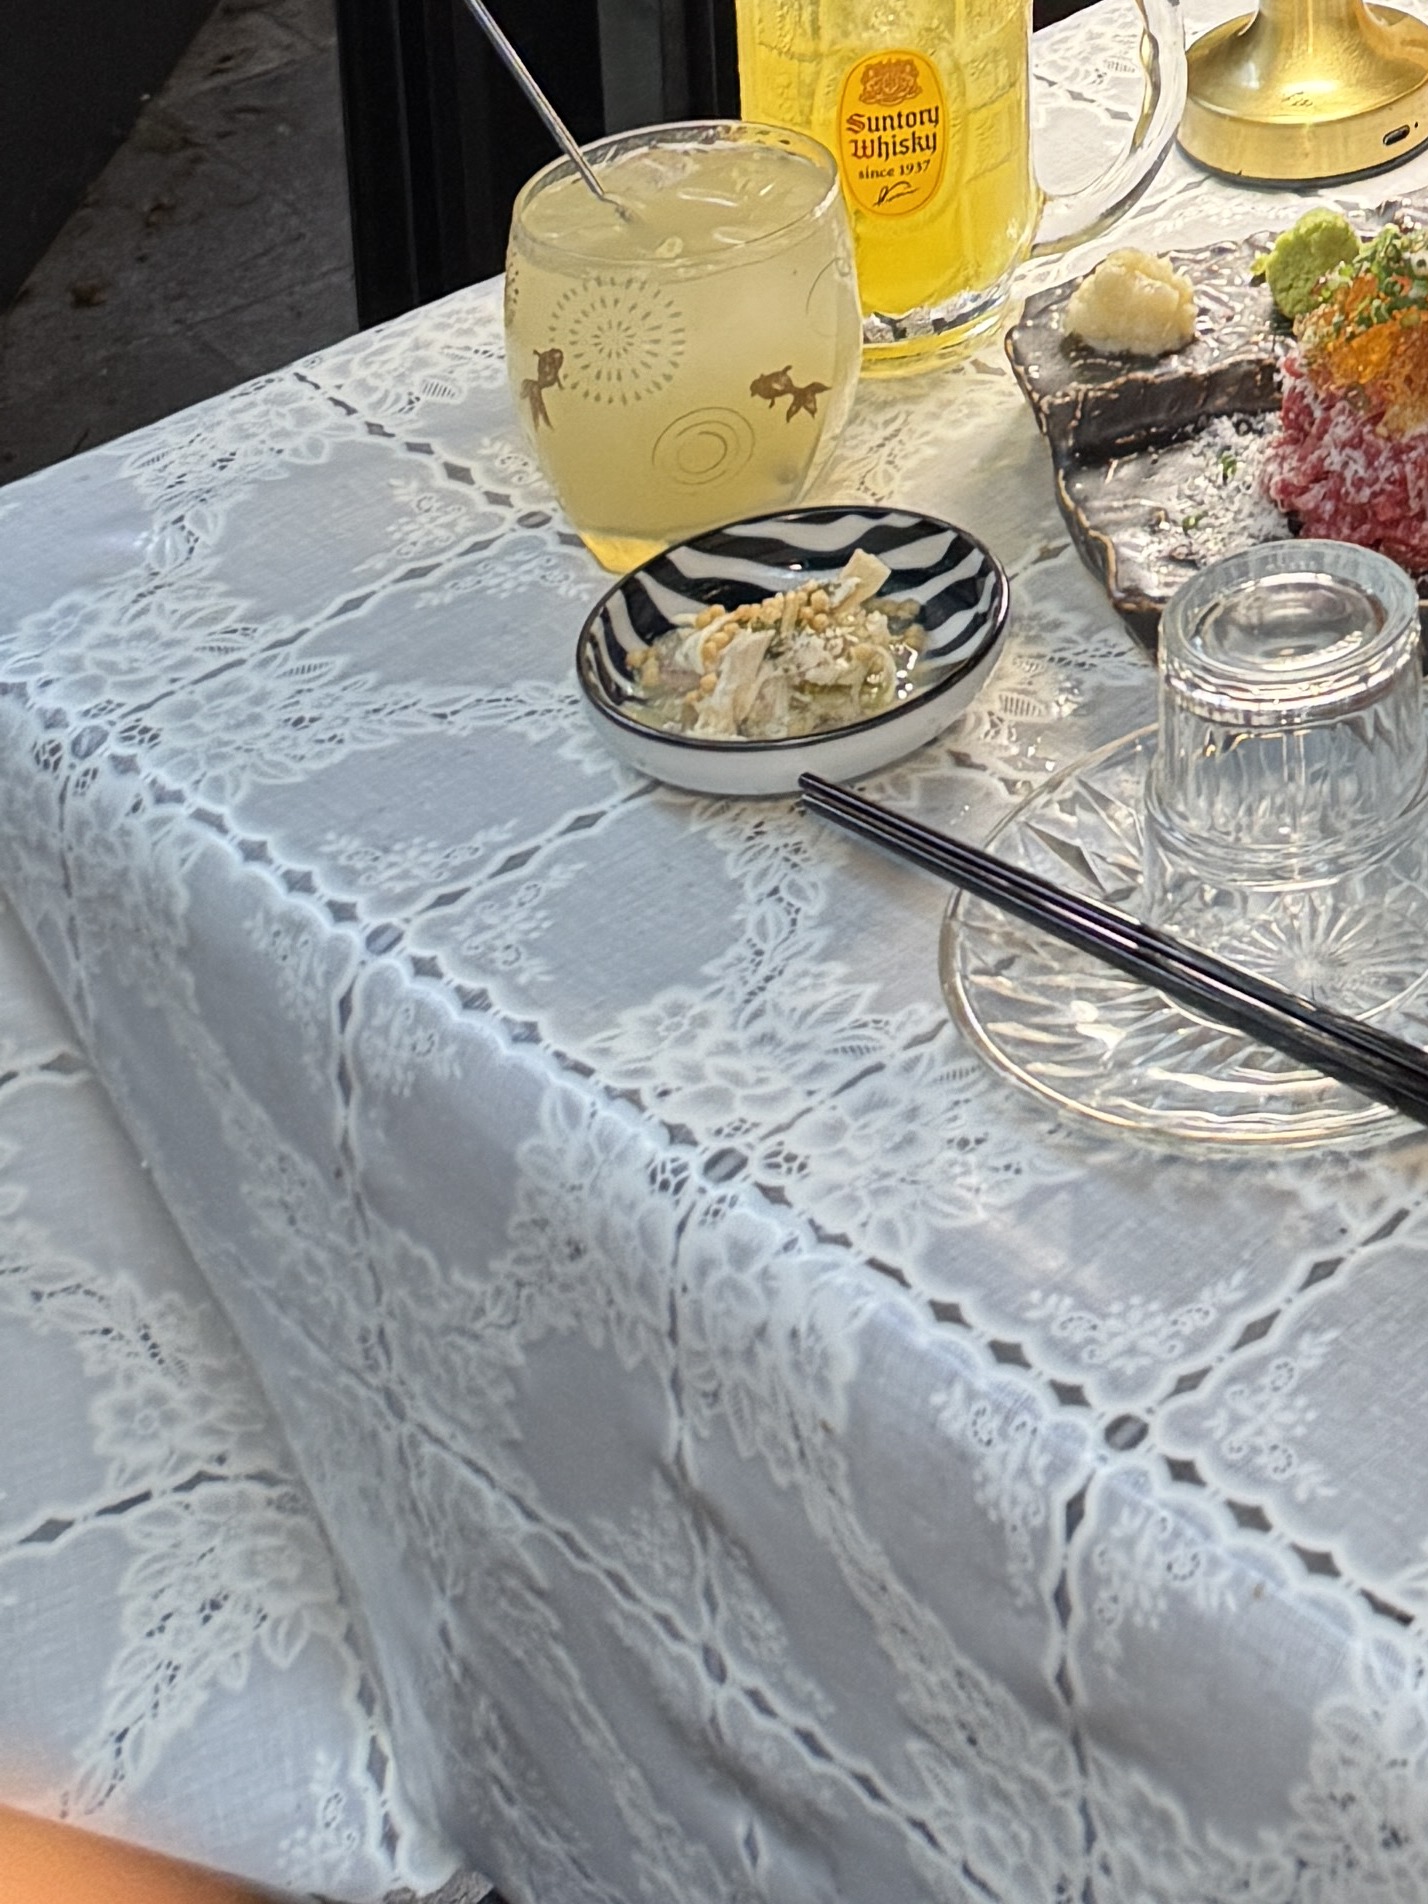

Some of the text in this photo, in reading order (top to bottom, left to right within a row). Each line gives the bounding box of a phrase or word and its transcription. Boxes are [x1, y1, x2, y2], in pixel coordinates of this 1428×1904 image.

[846, 105, 940, 135] Suntory
[849, 130, 938, 162] Whisky
[858, 159, 931, 180] since 1937
